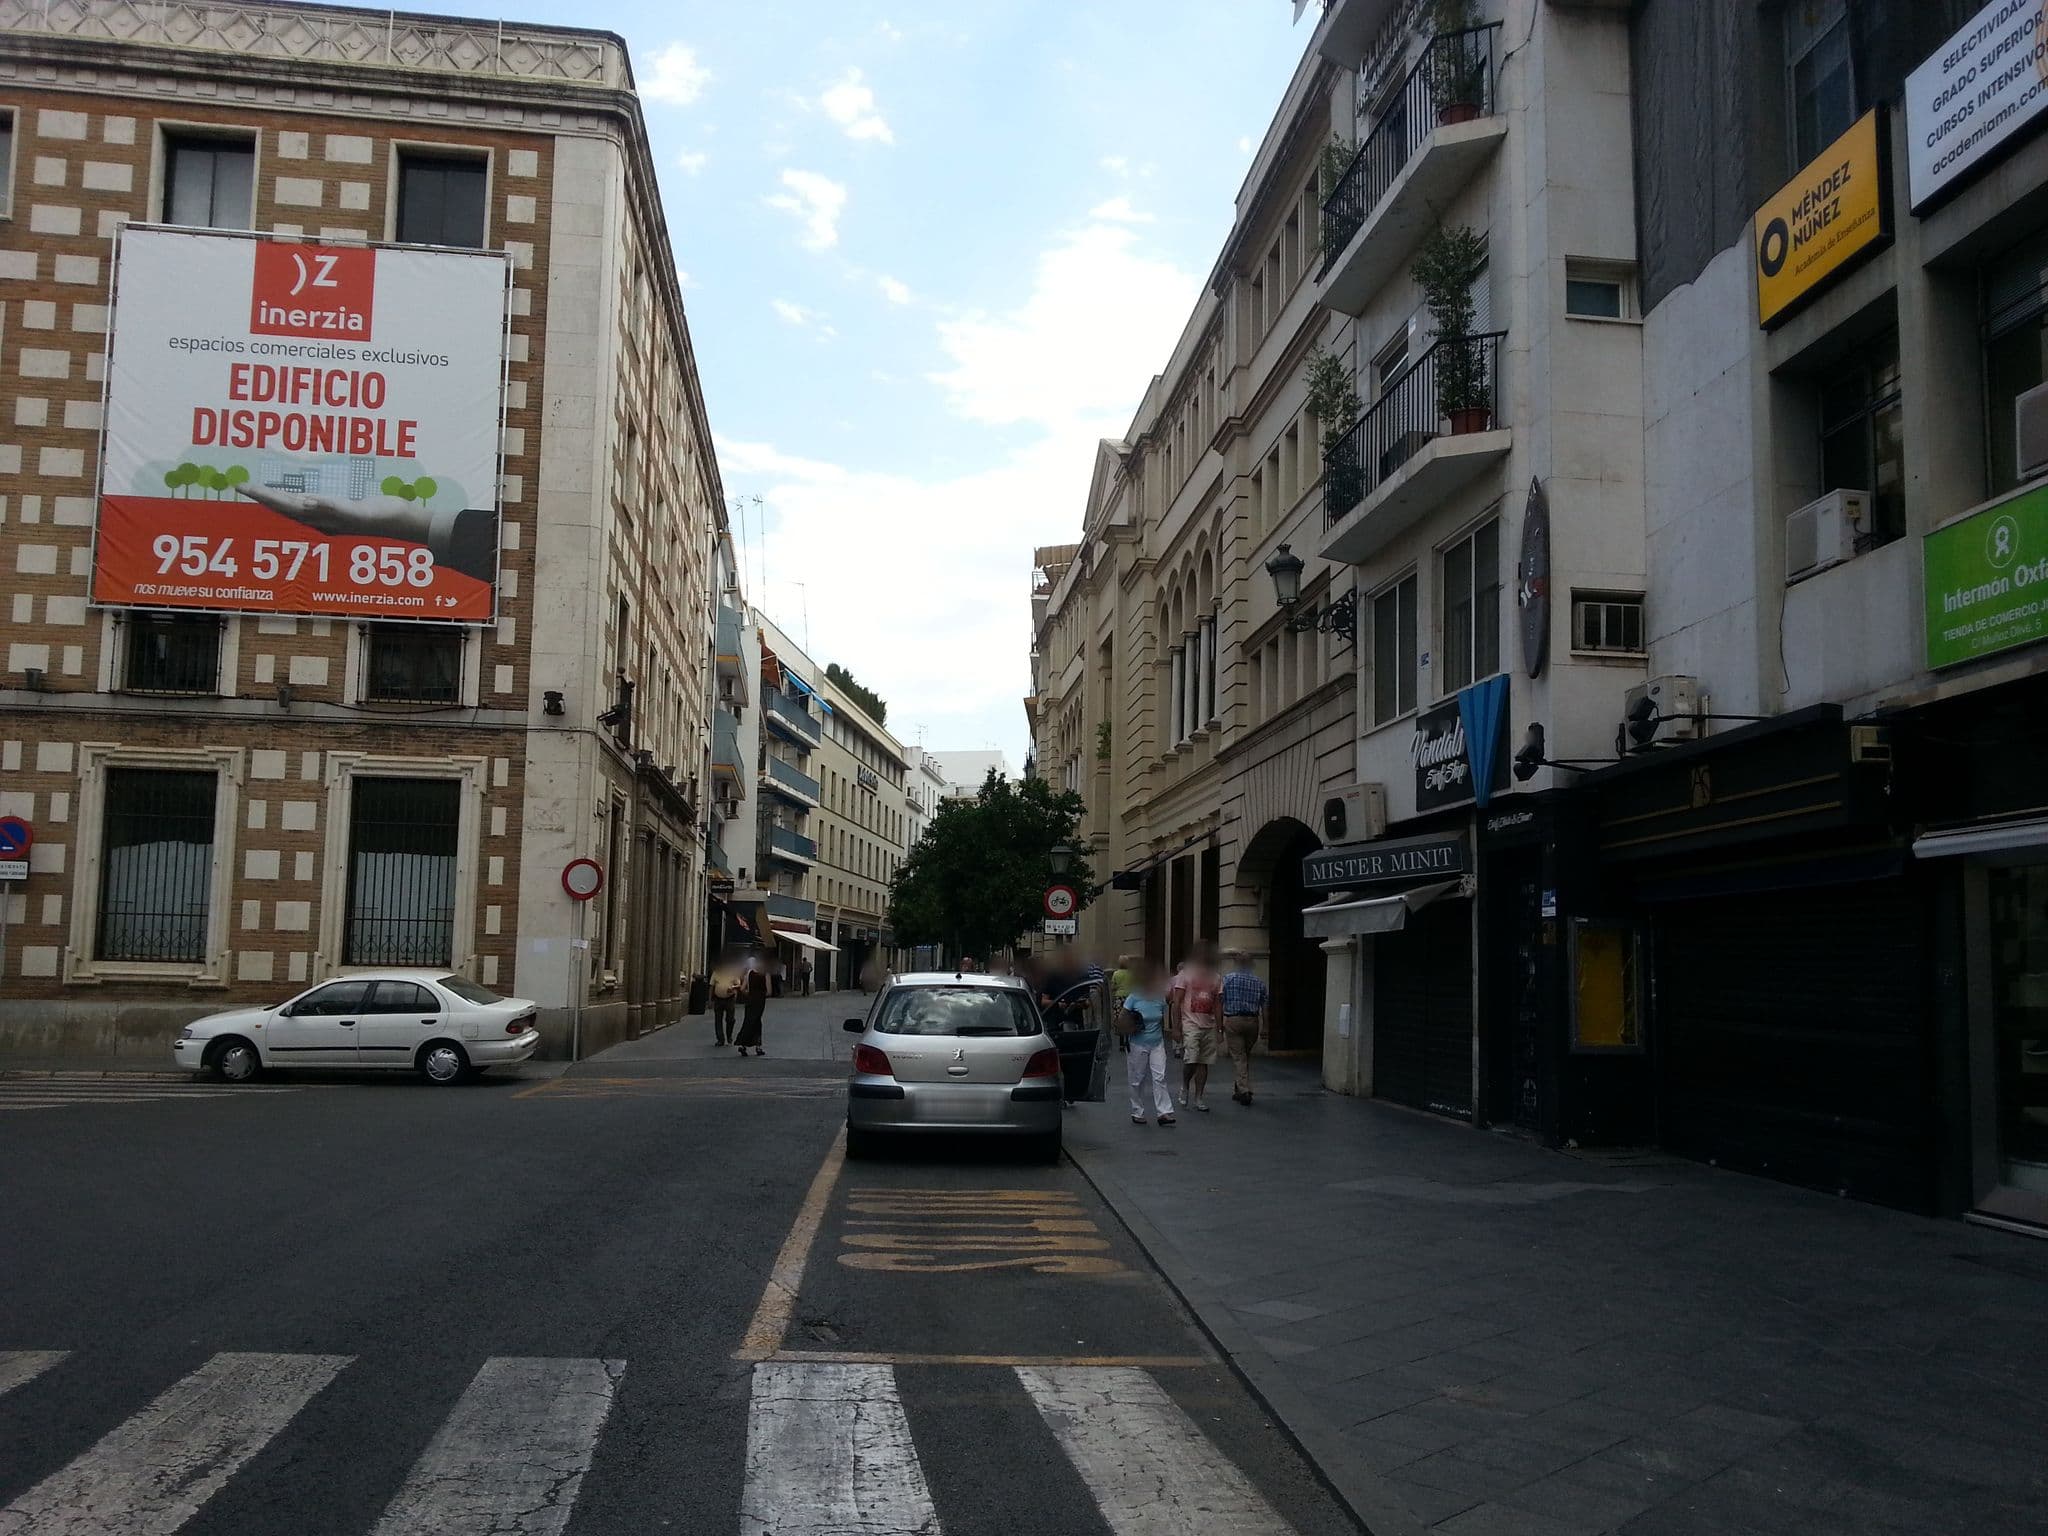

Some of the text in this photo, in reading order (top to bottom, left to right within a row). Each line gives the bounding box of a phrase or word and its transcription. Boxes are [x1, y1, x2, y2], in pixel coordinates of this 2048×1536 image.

[1932, 10, 2043, 113] GRADO SUPERIOR
[1926, 38, 2048, 148] CURSOS INTENSIVO
[1792, 160, 1851, 226] MÉNDEZ
[1793, 196, 1841, 251] NÚÑEZ
[259, 300, 364, 331] inerzia
[168, 335, 449, 367] espacios comerciales exclusivos
[228, 363, 386, 409] EDIFICIO
[191, 407, 418, 458] DISPONIBLE
[152, 534, 435, 587] 954 571 858
[134, 583, 274, 601] nos mueve su confianza
[312, 590, 425, 607] www.inerzia.com
[1944, 575, 2009, 614] Intermón
[1943, 623, 1973, 642] TIENDA
[1975, 618, 1988, 632] DE
[1990, 602, 2039, 626] COMERCIO
[1311, 846, 1453, 881] MISTER MINIT
